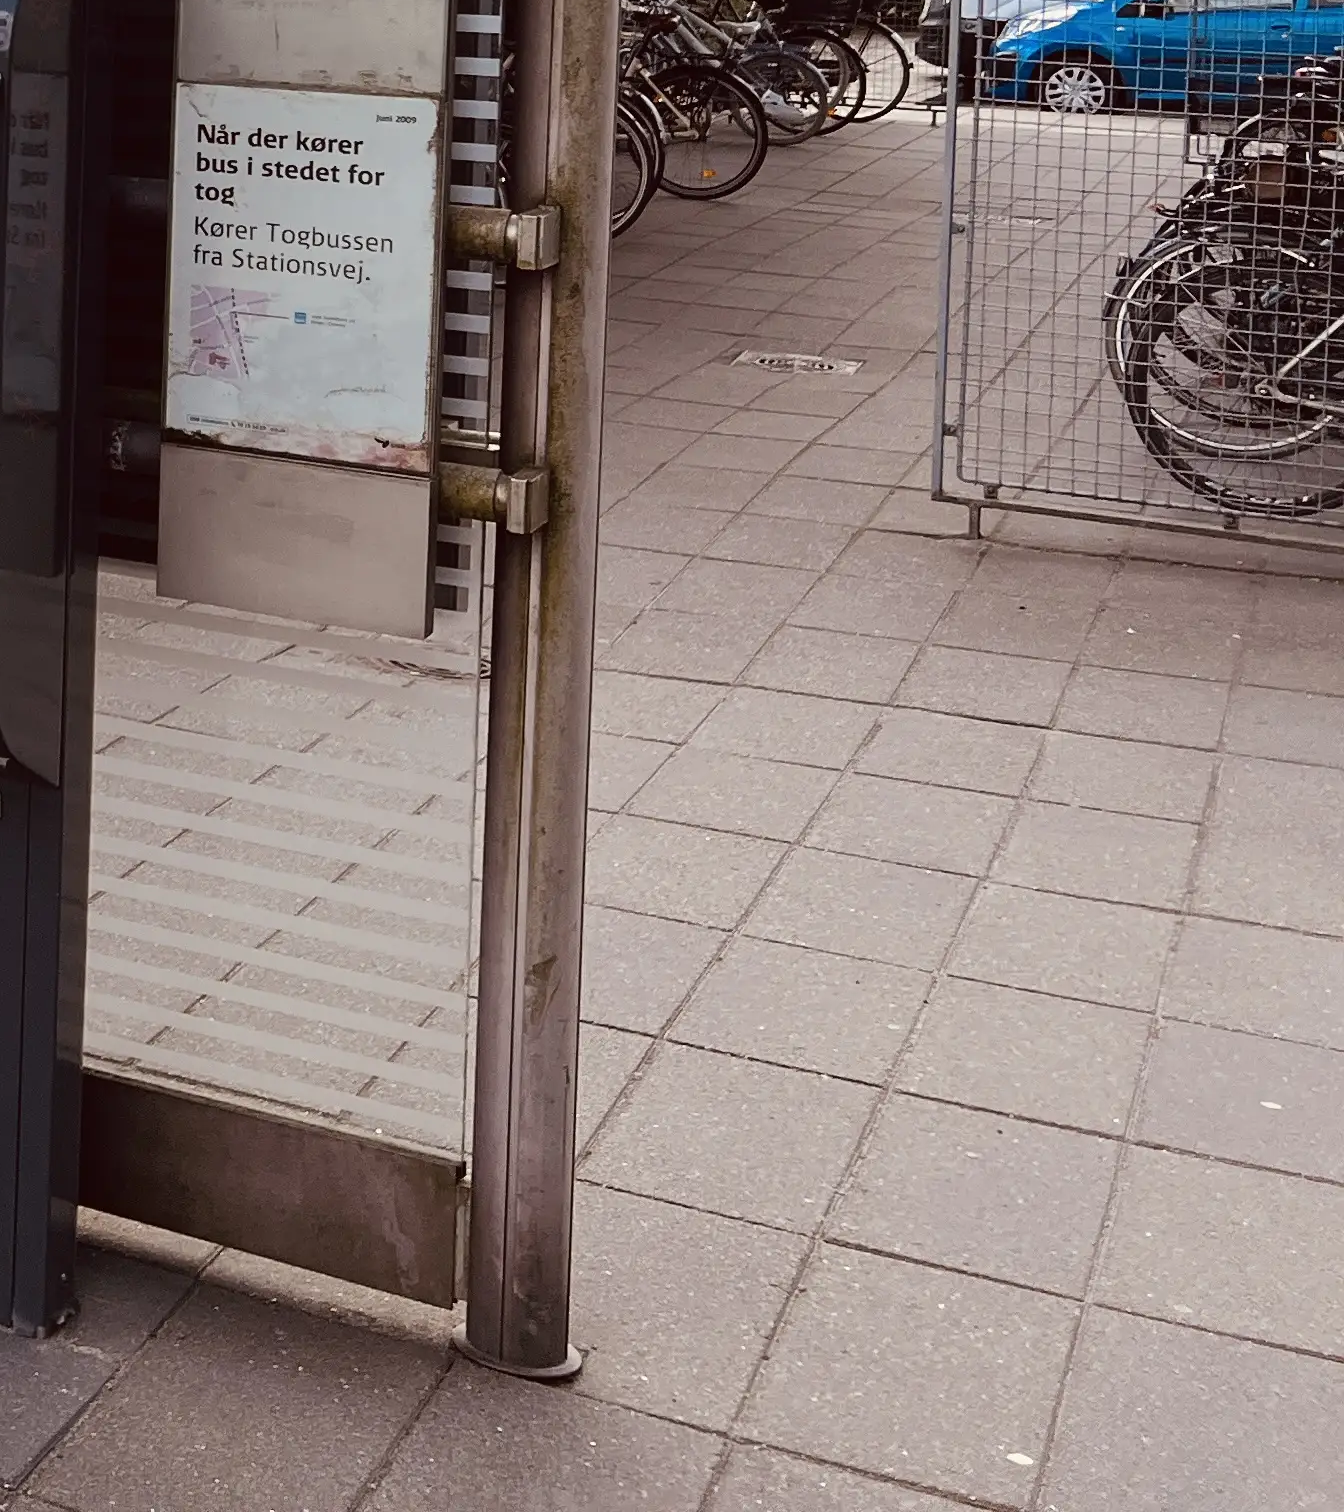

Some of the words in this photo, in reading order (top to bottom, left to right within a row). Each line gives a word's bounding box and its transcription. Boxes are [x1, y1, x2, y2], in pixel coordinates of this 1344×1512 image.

[375, 114, 393, 124] Juni
[395, 115, 417, 124] 2009
[196, 123, 241, 146] Når
[247, 127, 289, 150] der
[296, 131, 363, 156] kører
[196, 153, 239, 175] bus
[247, 156, 253, 176] i
[261, 159, 340, 184] stedet
[347, 164, 385, 187] for
[195, 183, 235, 207] tog
[193, 215, 258, 242] Kører
[266, 222, 394, 255] Togbussen
[193, 244, 223, 267] fra
[231, 248, 371, 285] Stationsvej.
